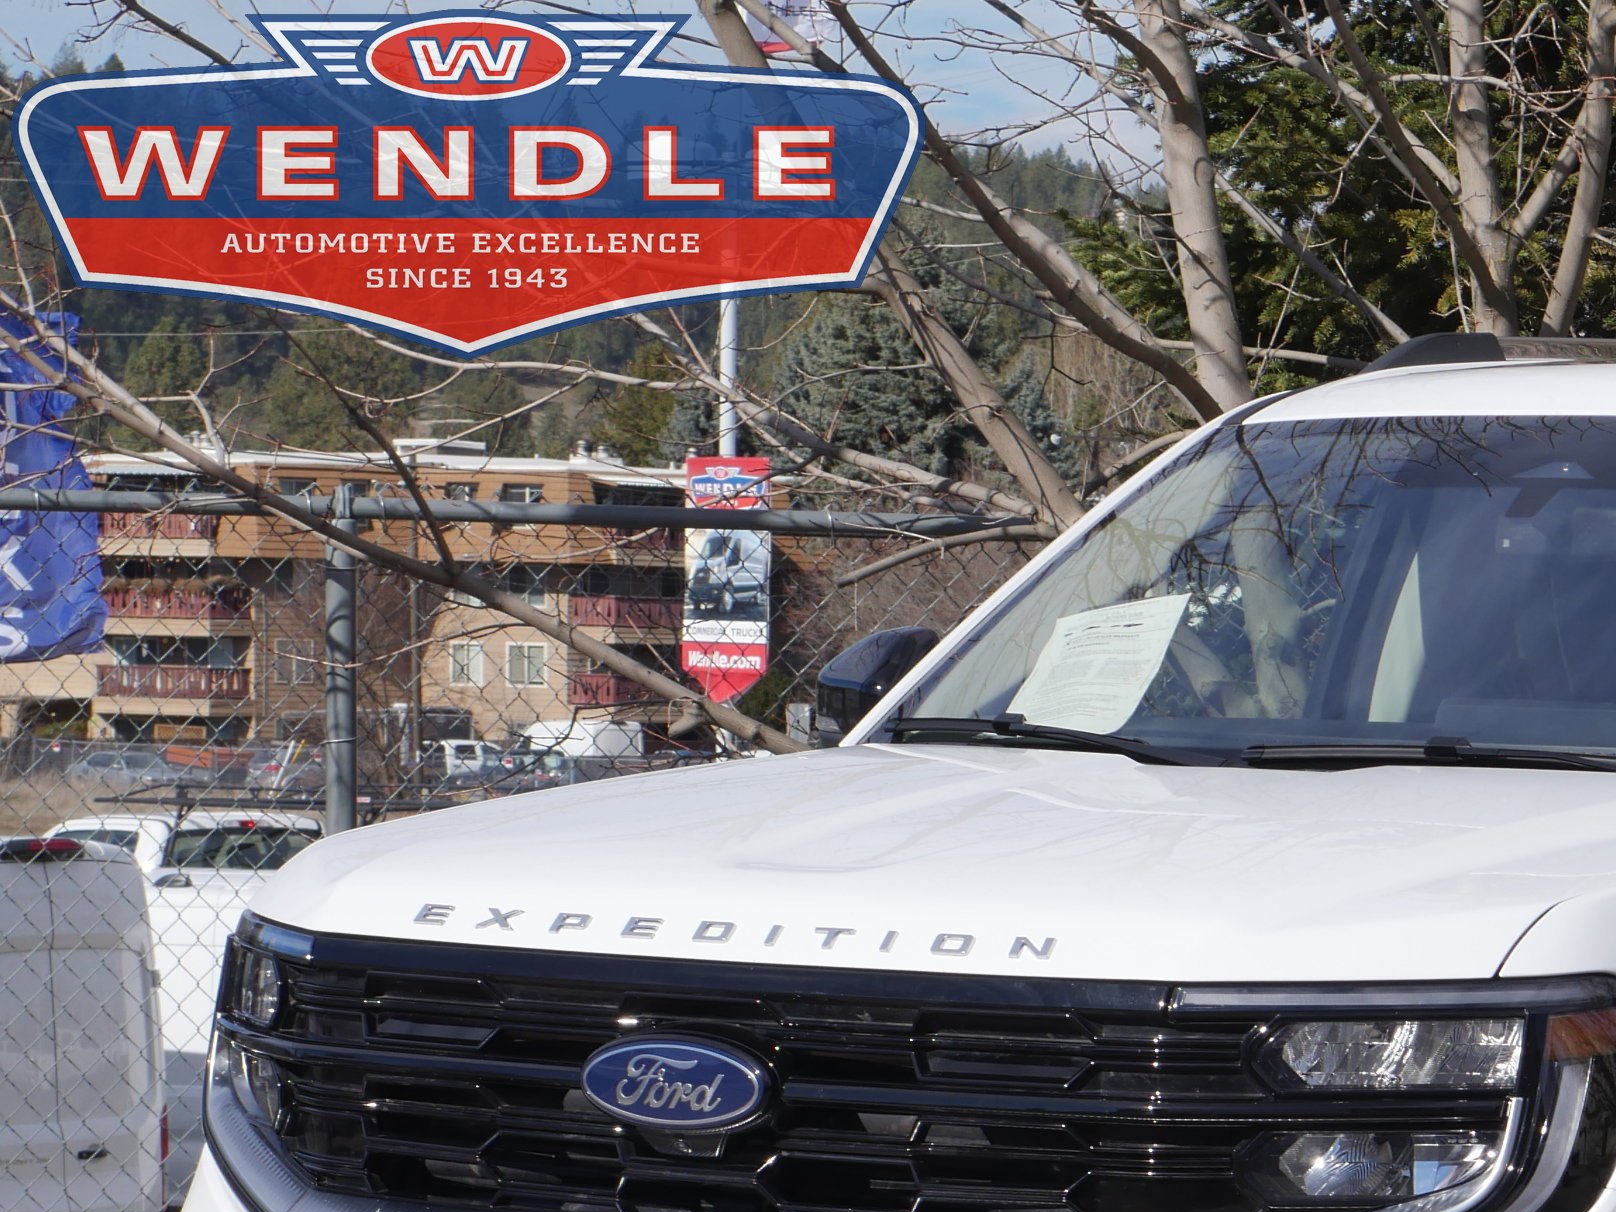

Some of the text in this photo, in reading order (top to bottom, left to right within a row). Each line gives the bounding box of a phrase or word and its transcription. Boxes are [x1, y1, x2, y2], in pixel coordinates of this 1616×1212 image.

[694, 482, 759, 496] WEND
[731, 627, 763, 638] TRUCK
[412, 902, 1058, 960] EXPEDITION
[615, 1052, 725, 1113] Ford
